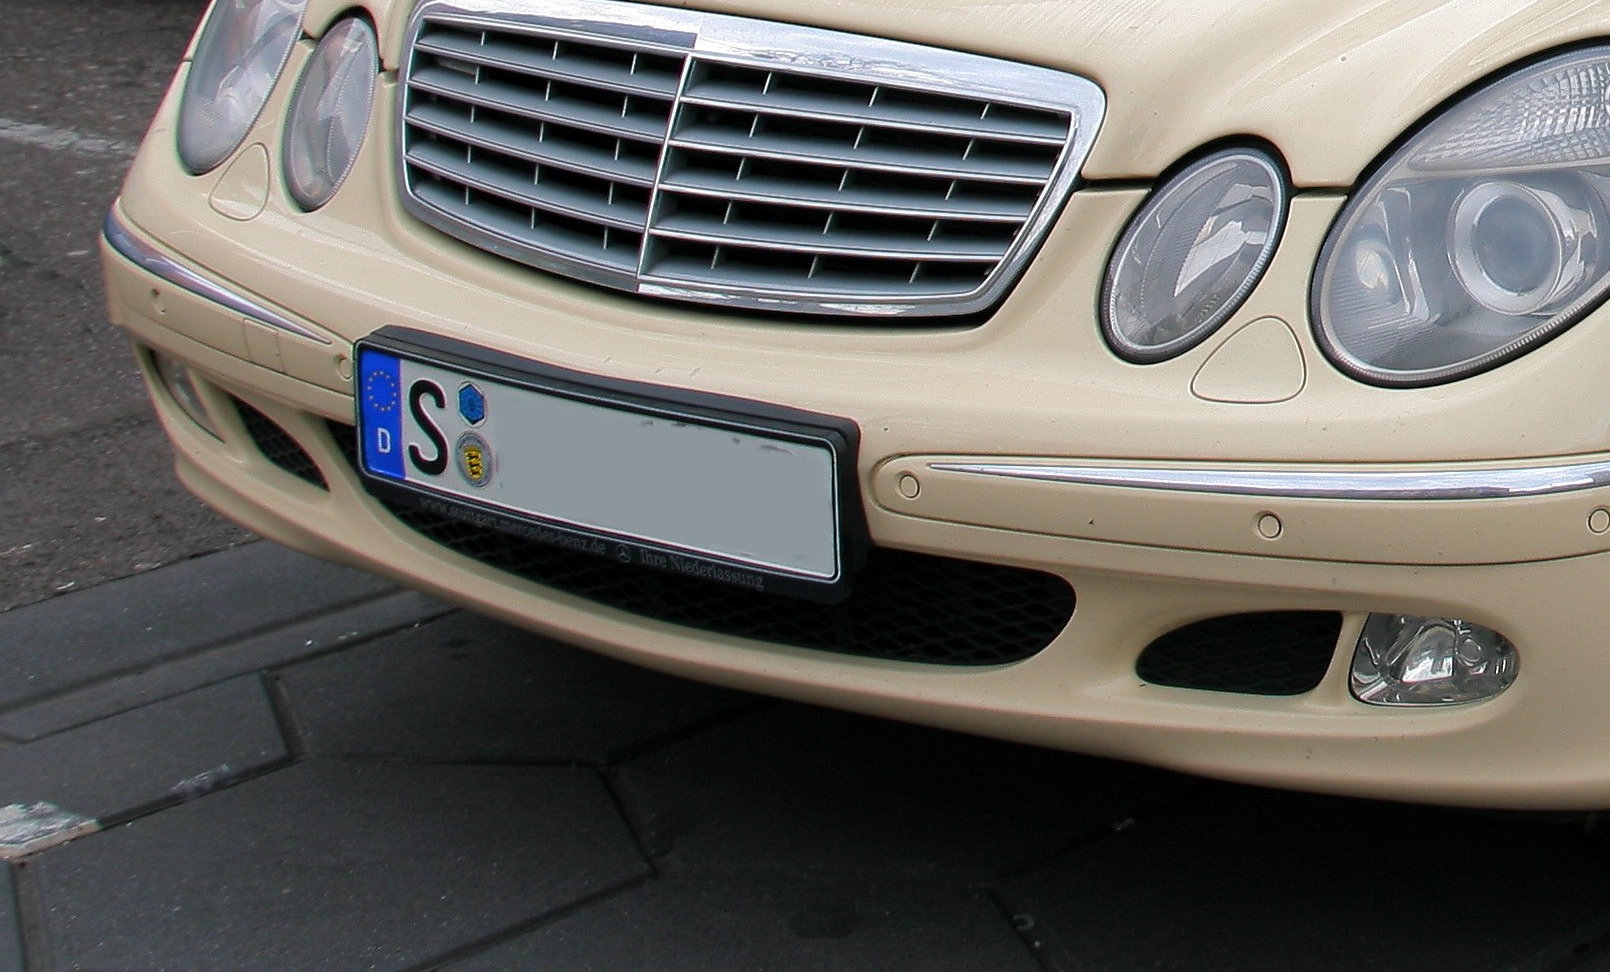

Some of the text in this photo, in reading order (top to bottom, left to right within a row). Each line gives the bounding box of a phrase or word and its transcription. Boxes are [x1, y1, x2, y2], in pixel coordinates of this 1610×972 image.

[377, 427, 391, 454] D
[407, 379, 449, 475] S
[669, 555, 765, 591] Niederlassung
